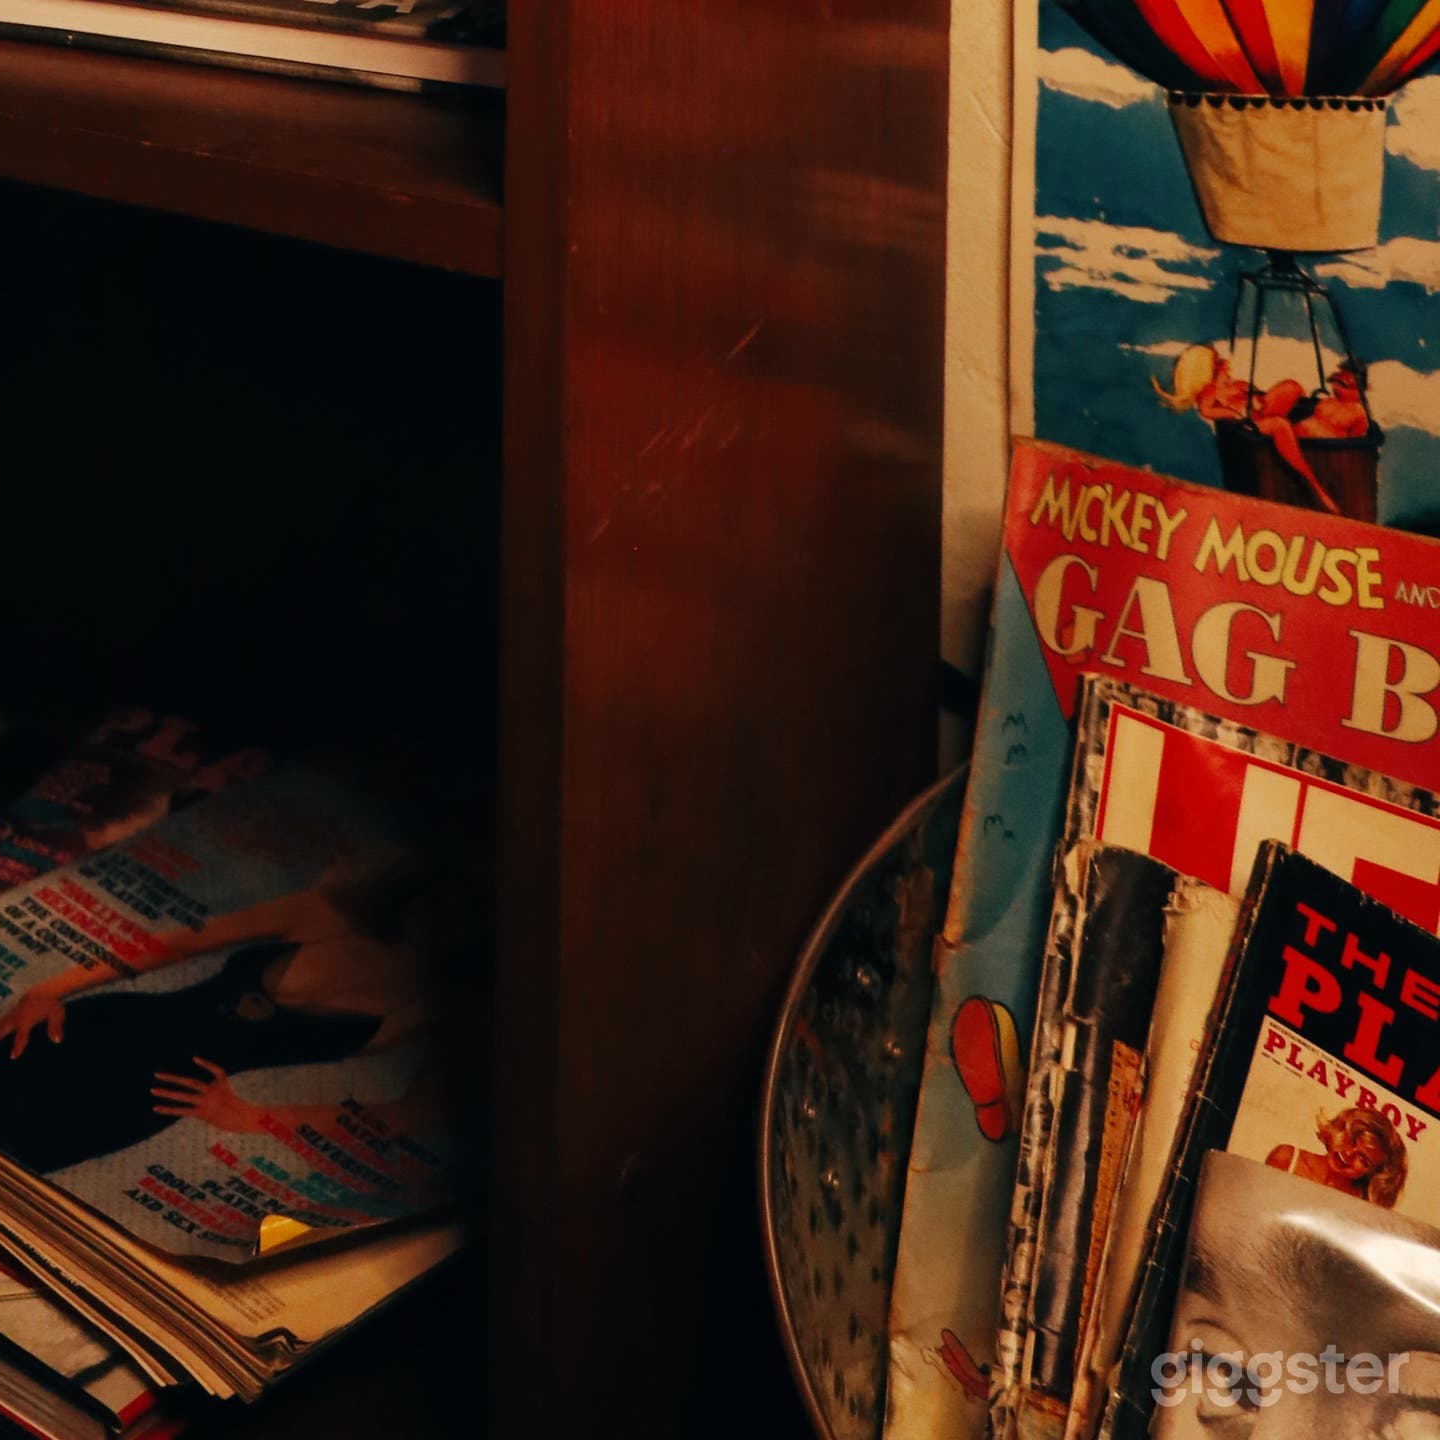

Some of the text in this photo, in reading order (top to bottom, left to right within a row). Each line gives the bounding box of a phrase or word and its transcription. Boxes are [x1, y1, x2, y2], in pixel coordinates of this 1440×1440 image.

[1030, 474, 1188, 561] MICKEY
[1194, 517, 1385, 610] MOUSE
[1034, 554, 1297, 706] GAG
[1296, 901, 1440, 1021] THE
[1263, 1028, 1427, 1142] PLAYBOY
